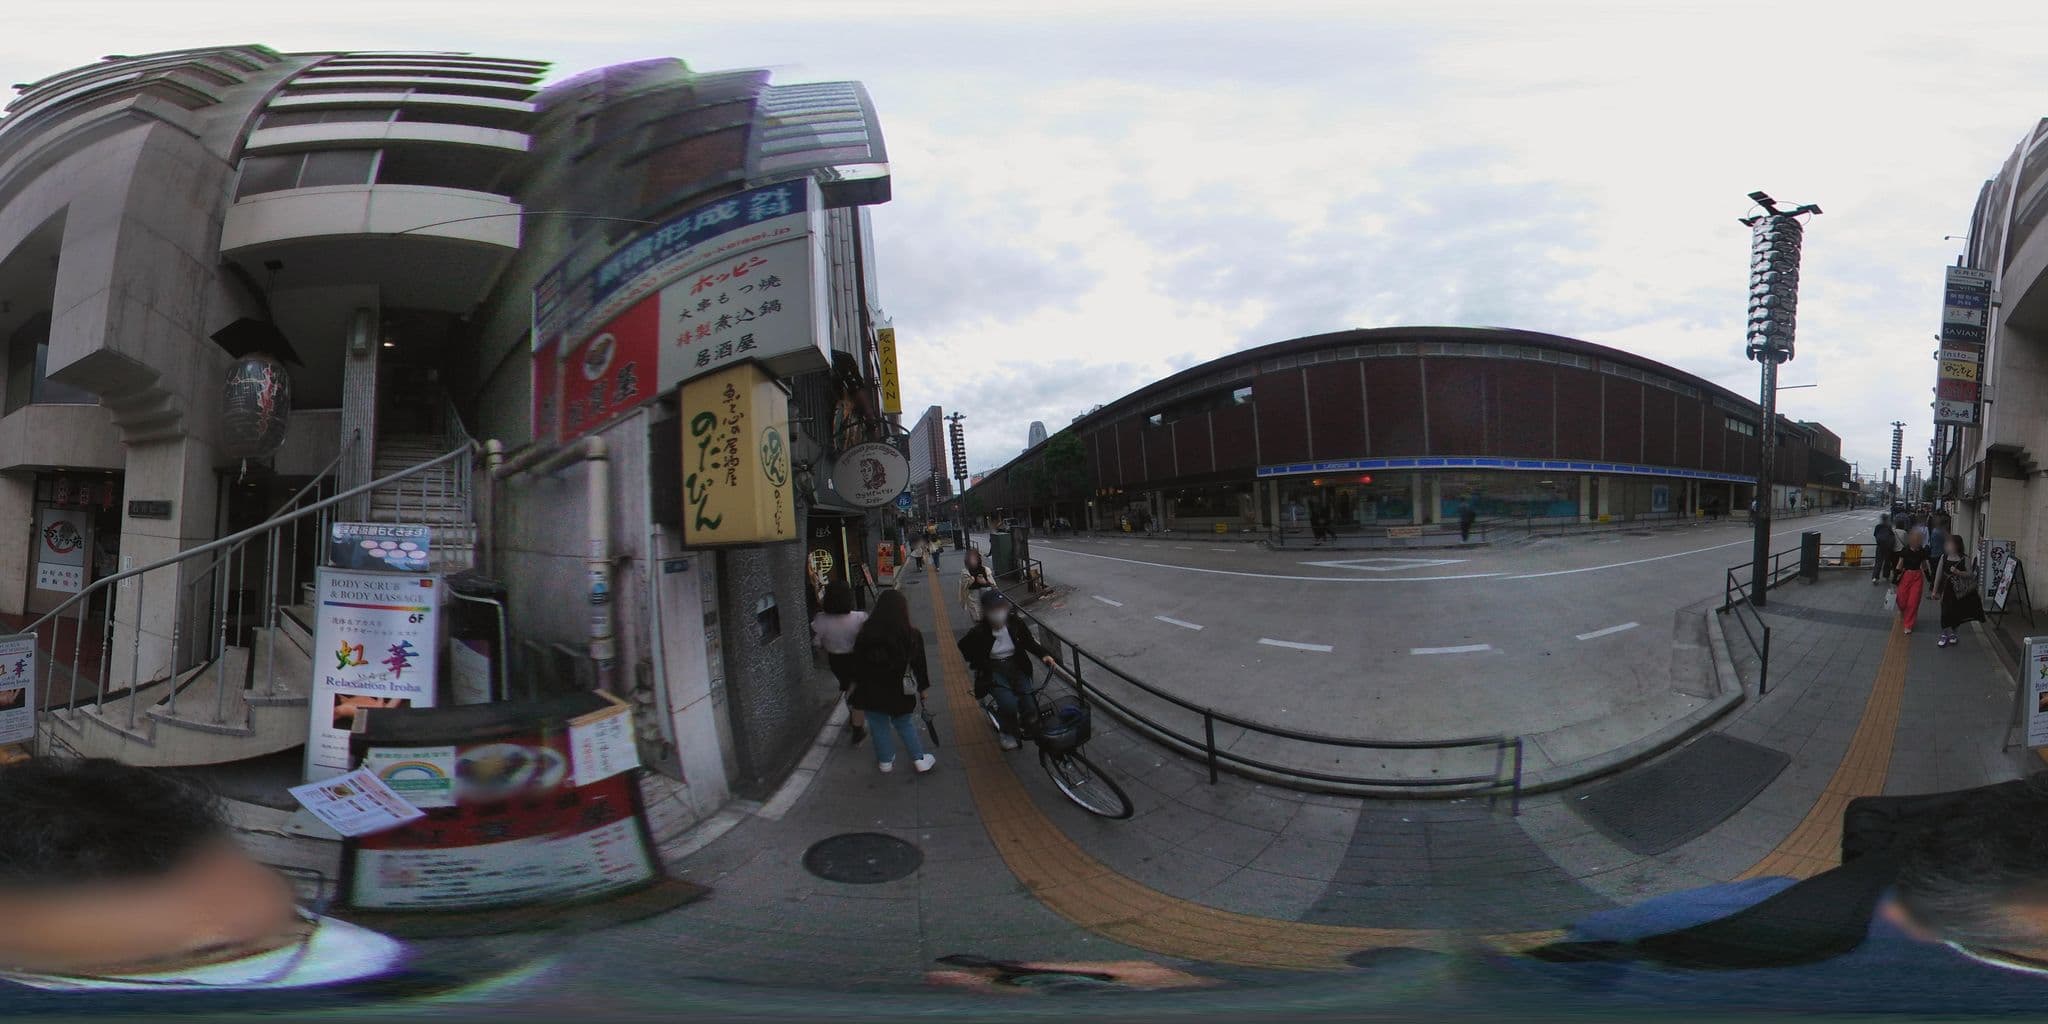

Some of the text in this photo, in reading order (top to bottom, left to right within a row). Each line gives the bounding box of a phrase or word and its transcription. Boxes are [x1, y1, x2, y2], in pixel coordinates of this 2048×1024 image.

[690, 256, 768, 296] ホッピー
[678, 274, 782, 325] 大串もつ焼
[675, 299, 782, 347] 特製煮込鍋
[694, 333, 758, 368] 居酒屋
[722, 382, 745, 487] 魚と心の居酒屋
[329, 590, 425, 603] & BODY MASSAGE
[331, 578, 360, 589] BODY
[363, 580, 401, 591] SCRUB
[408, 613, 425, 624] 6F
[325, 676, 422, 693] Relaxation Iroha
